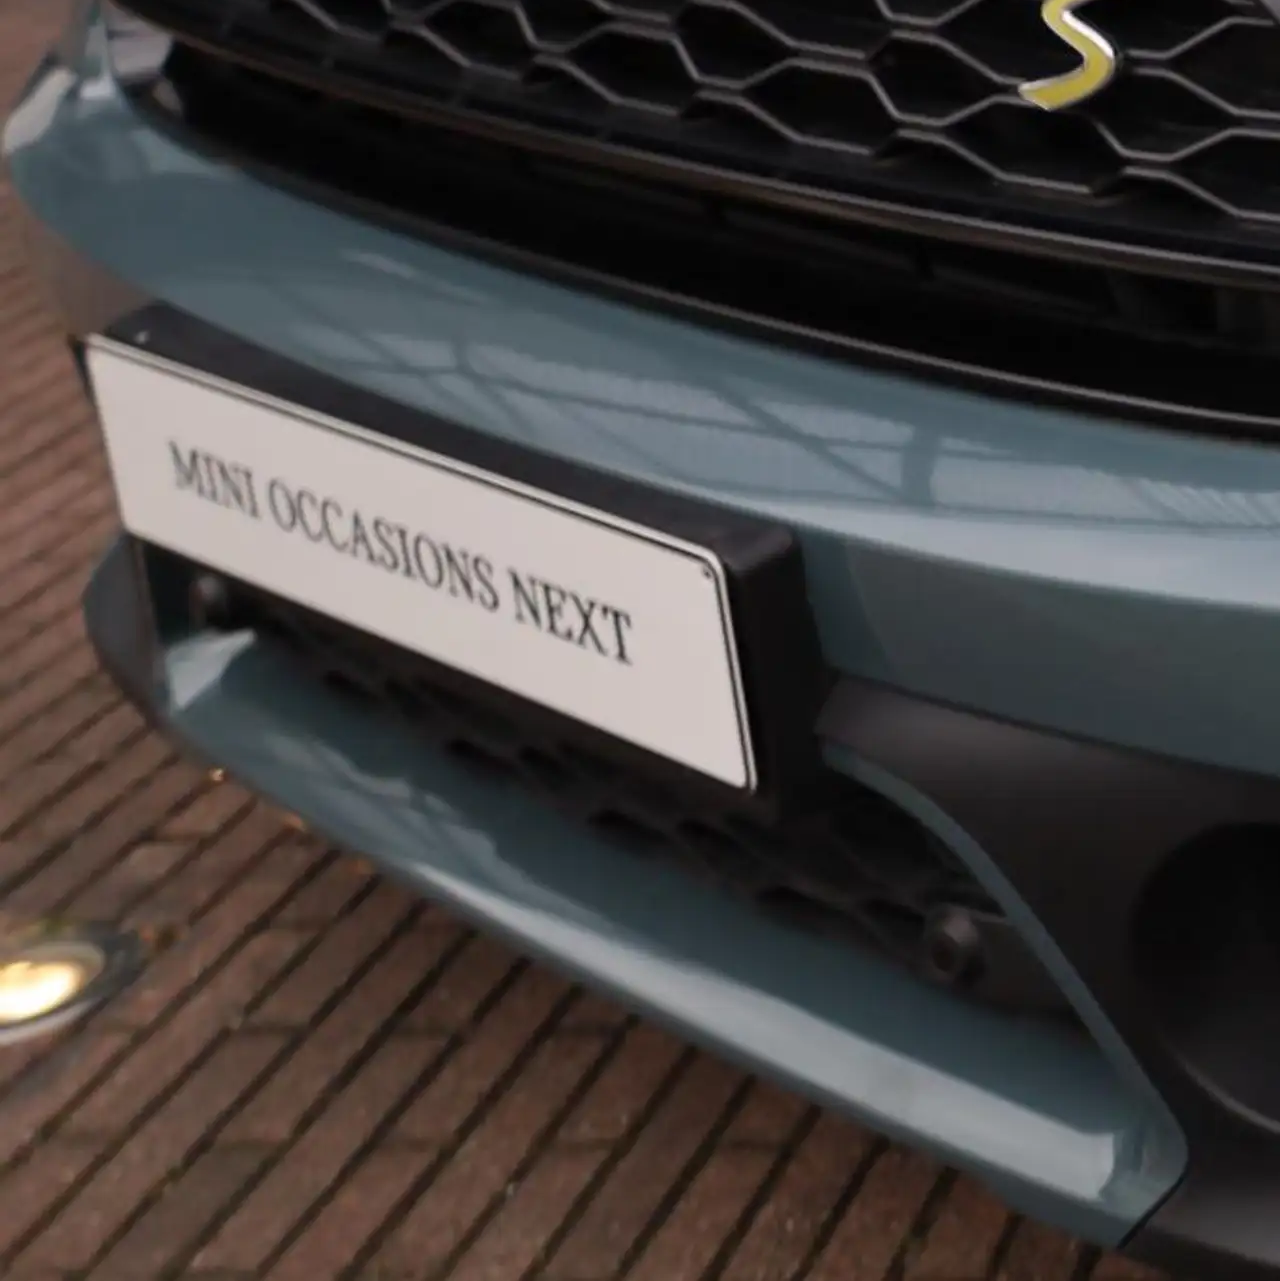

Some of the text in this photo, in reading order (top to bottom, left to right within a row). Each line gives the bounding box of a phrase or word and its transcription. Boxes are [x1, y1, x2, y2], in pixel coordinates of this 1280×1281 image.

[169, 440, 633, 666] MINI OCCASIONS NEXT
